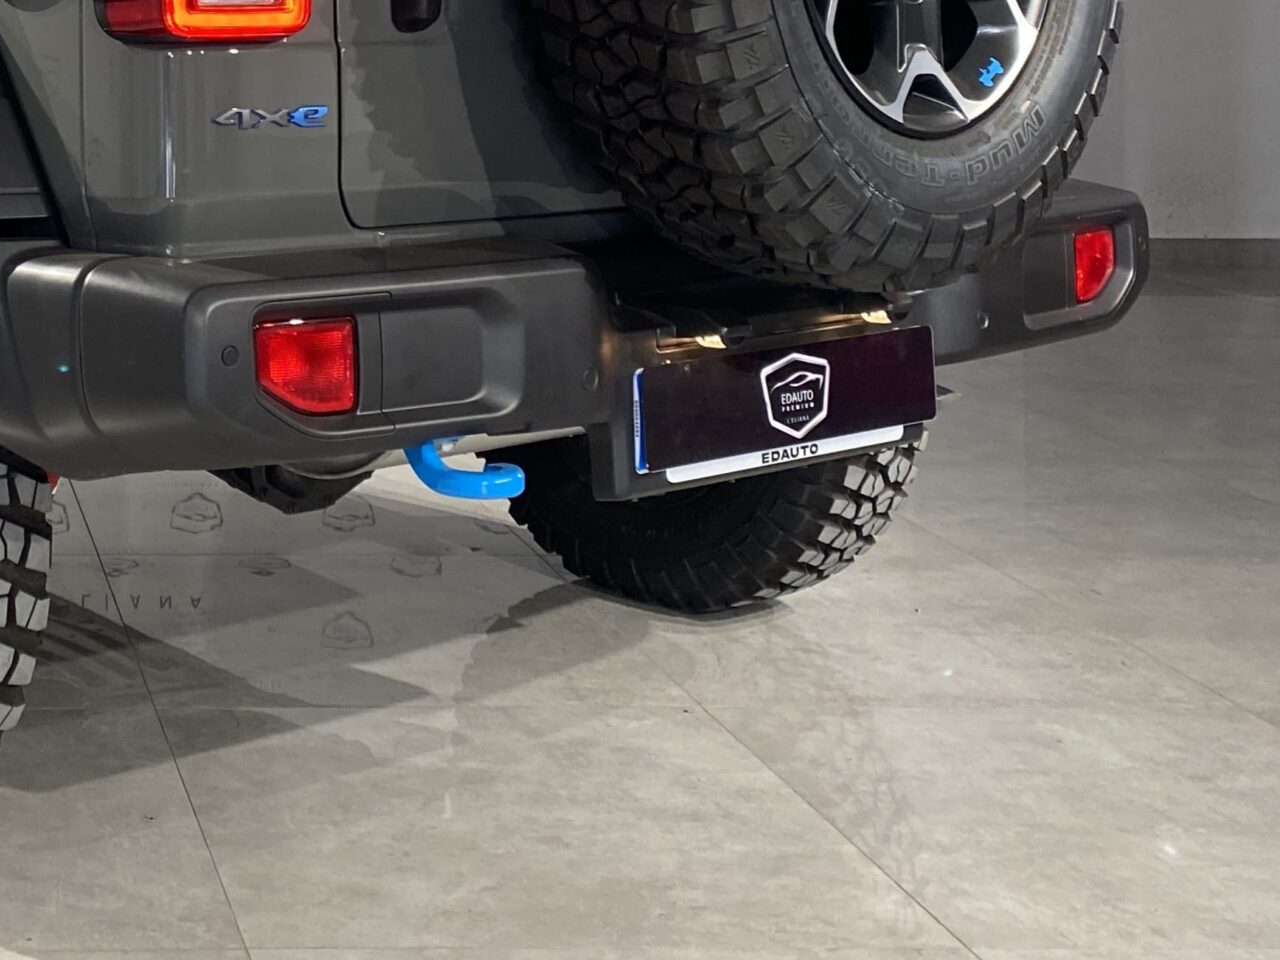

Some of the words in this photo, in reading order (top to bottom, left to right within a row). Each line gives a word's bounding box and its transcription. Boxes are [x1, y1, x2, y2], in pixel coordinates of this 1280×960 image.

[781, 390, 814, 405] EDAUTO
[781, 402, 814, 413] PREMIUM
[761, 443, 819, 464] EDAUTO
